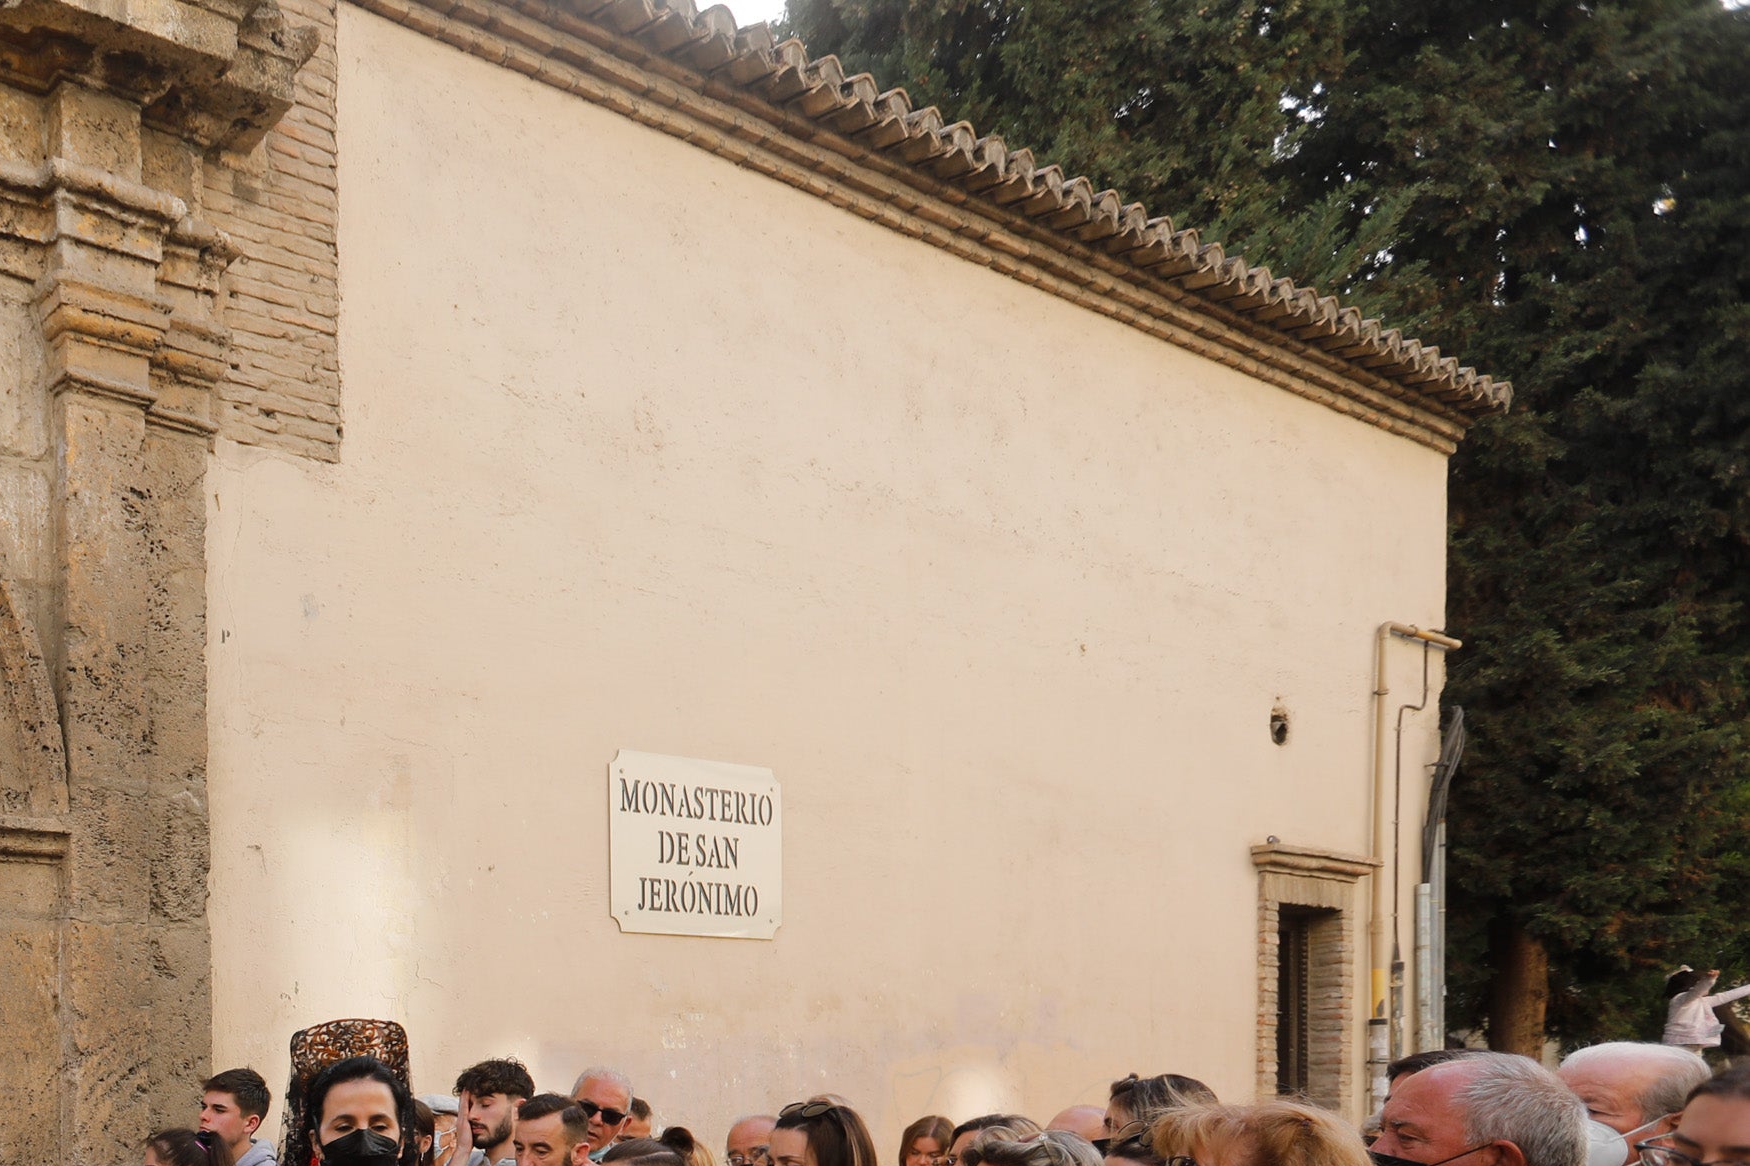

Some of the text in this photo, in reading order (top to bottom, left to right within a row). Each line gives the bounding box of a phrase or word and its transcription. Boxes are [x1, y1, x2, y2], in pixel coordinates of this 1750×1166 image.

[619, 777, 773, 826] MONASTERIO
[658, 830, 739, 870] DE SAN
[637, 870, 758, 917] JERÓNIMO
